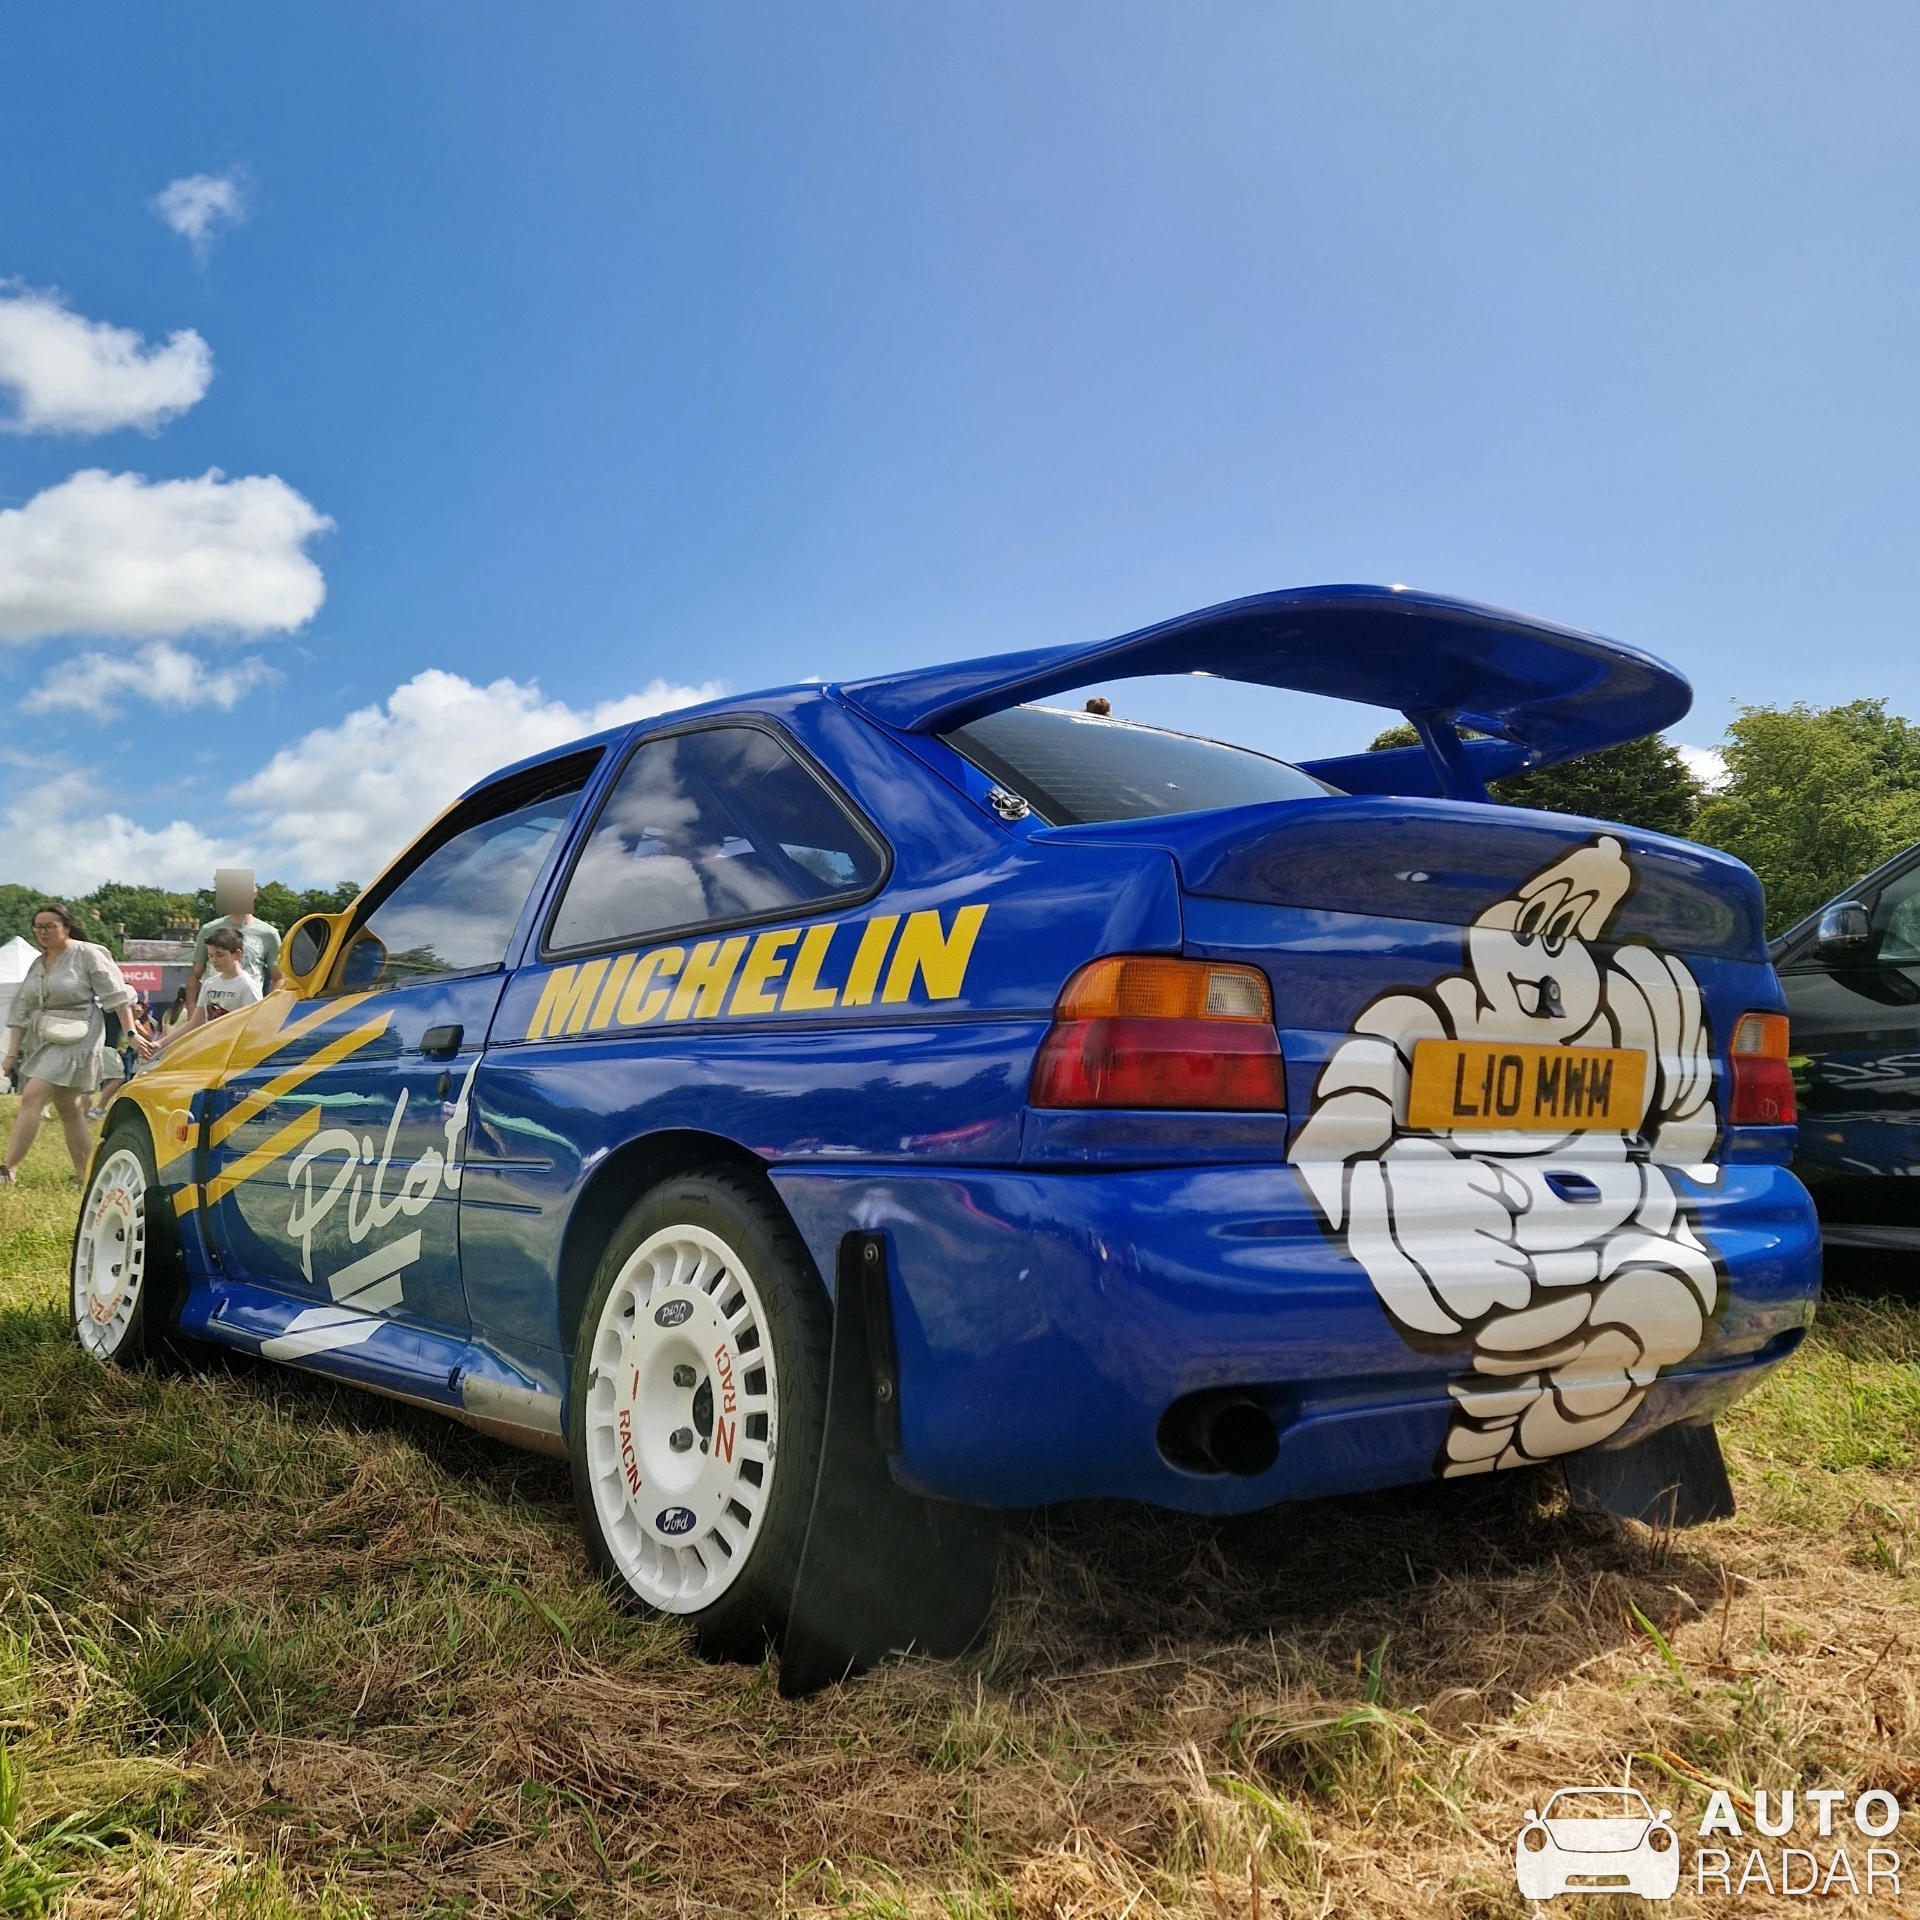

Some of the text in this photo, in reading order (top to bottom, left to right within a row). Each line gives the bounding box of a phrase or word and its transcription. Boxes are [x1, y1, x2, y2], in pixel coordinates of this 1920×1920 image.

[525, 903, 989, 1041] MICHELIN
[1453, 1053, 1614, 1117] L10 MWM
[287, 1053, 483, 1283] Pilot
[662, 1302, 687, 1326] Ford
[663, 1508, 689, 1532] Ford
